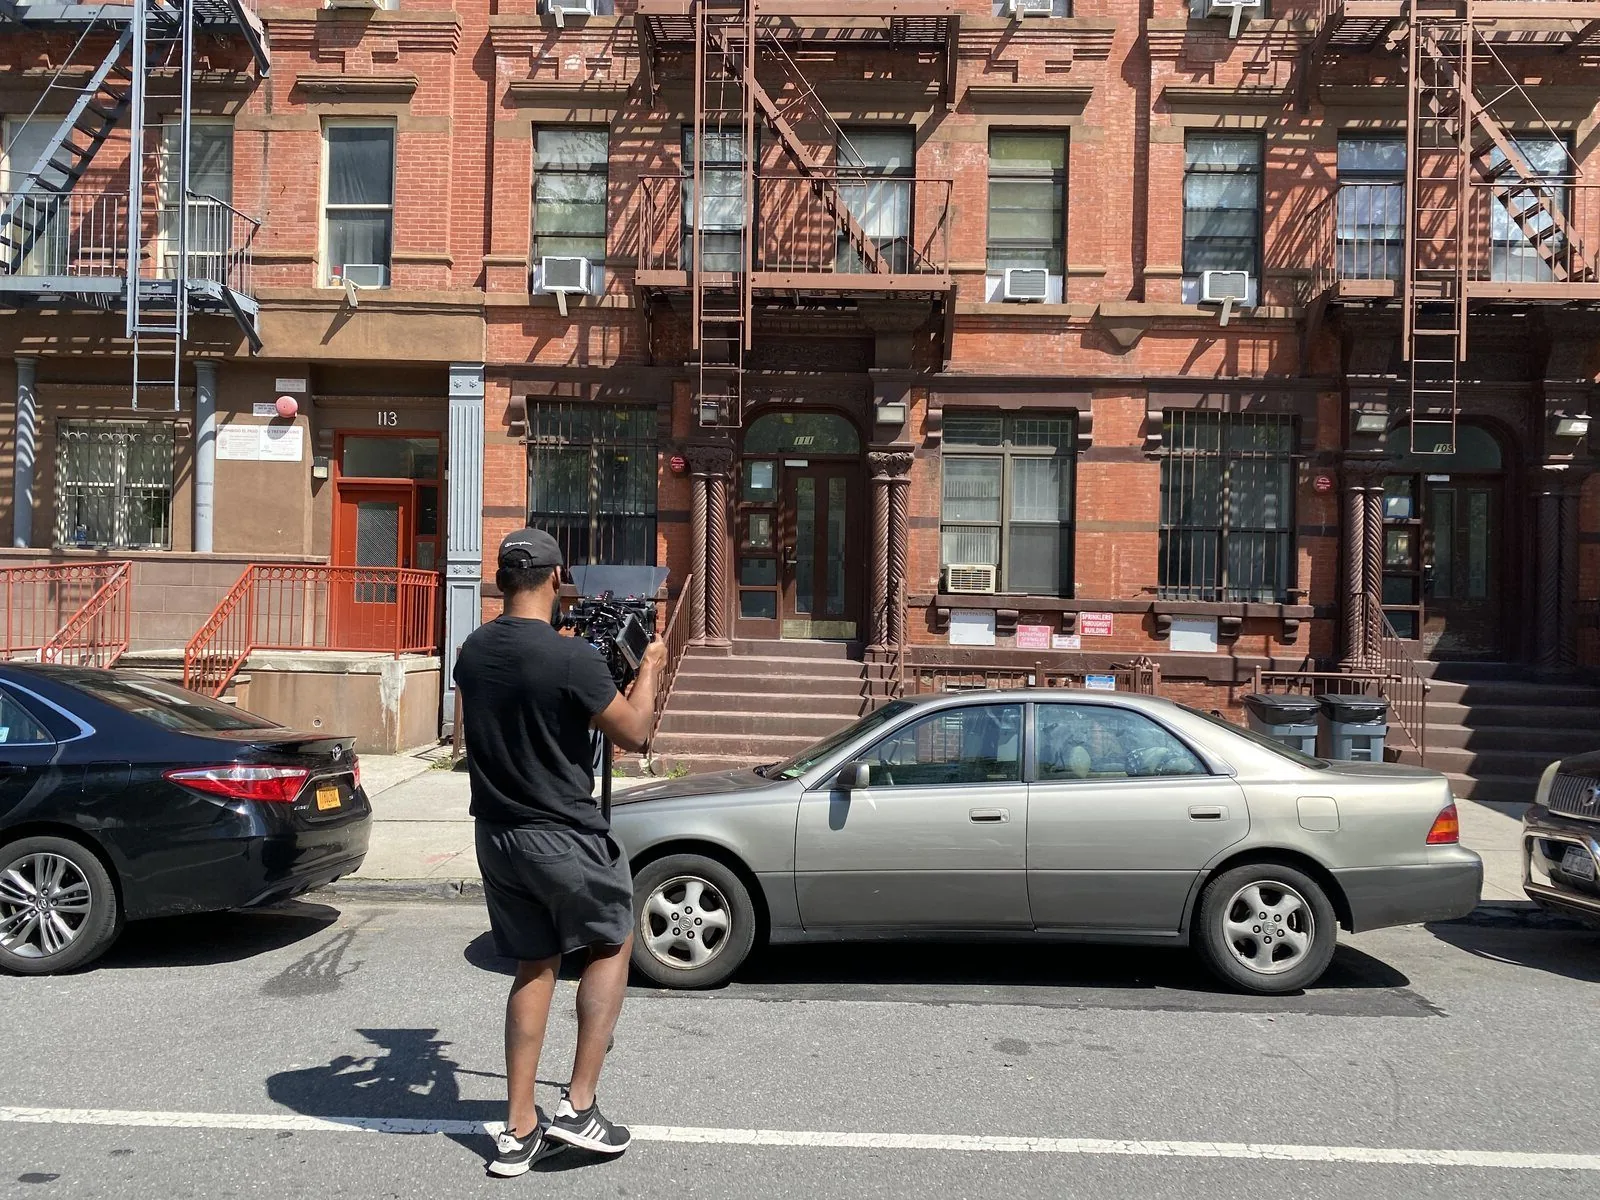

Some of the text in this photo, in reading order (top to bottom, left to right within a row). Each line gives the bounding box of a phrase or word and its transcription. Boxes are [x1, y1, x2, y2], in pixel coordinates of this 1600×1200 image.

[378, 411, 397, 426] 113
[504, 540, 533, 548] Champion
[1082, 620, 1110, 628] THROUGHOUT
[1084, 627, 1109, 635] BUILDING
